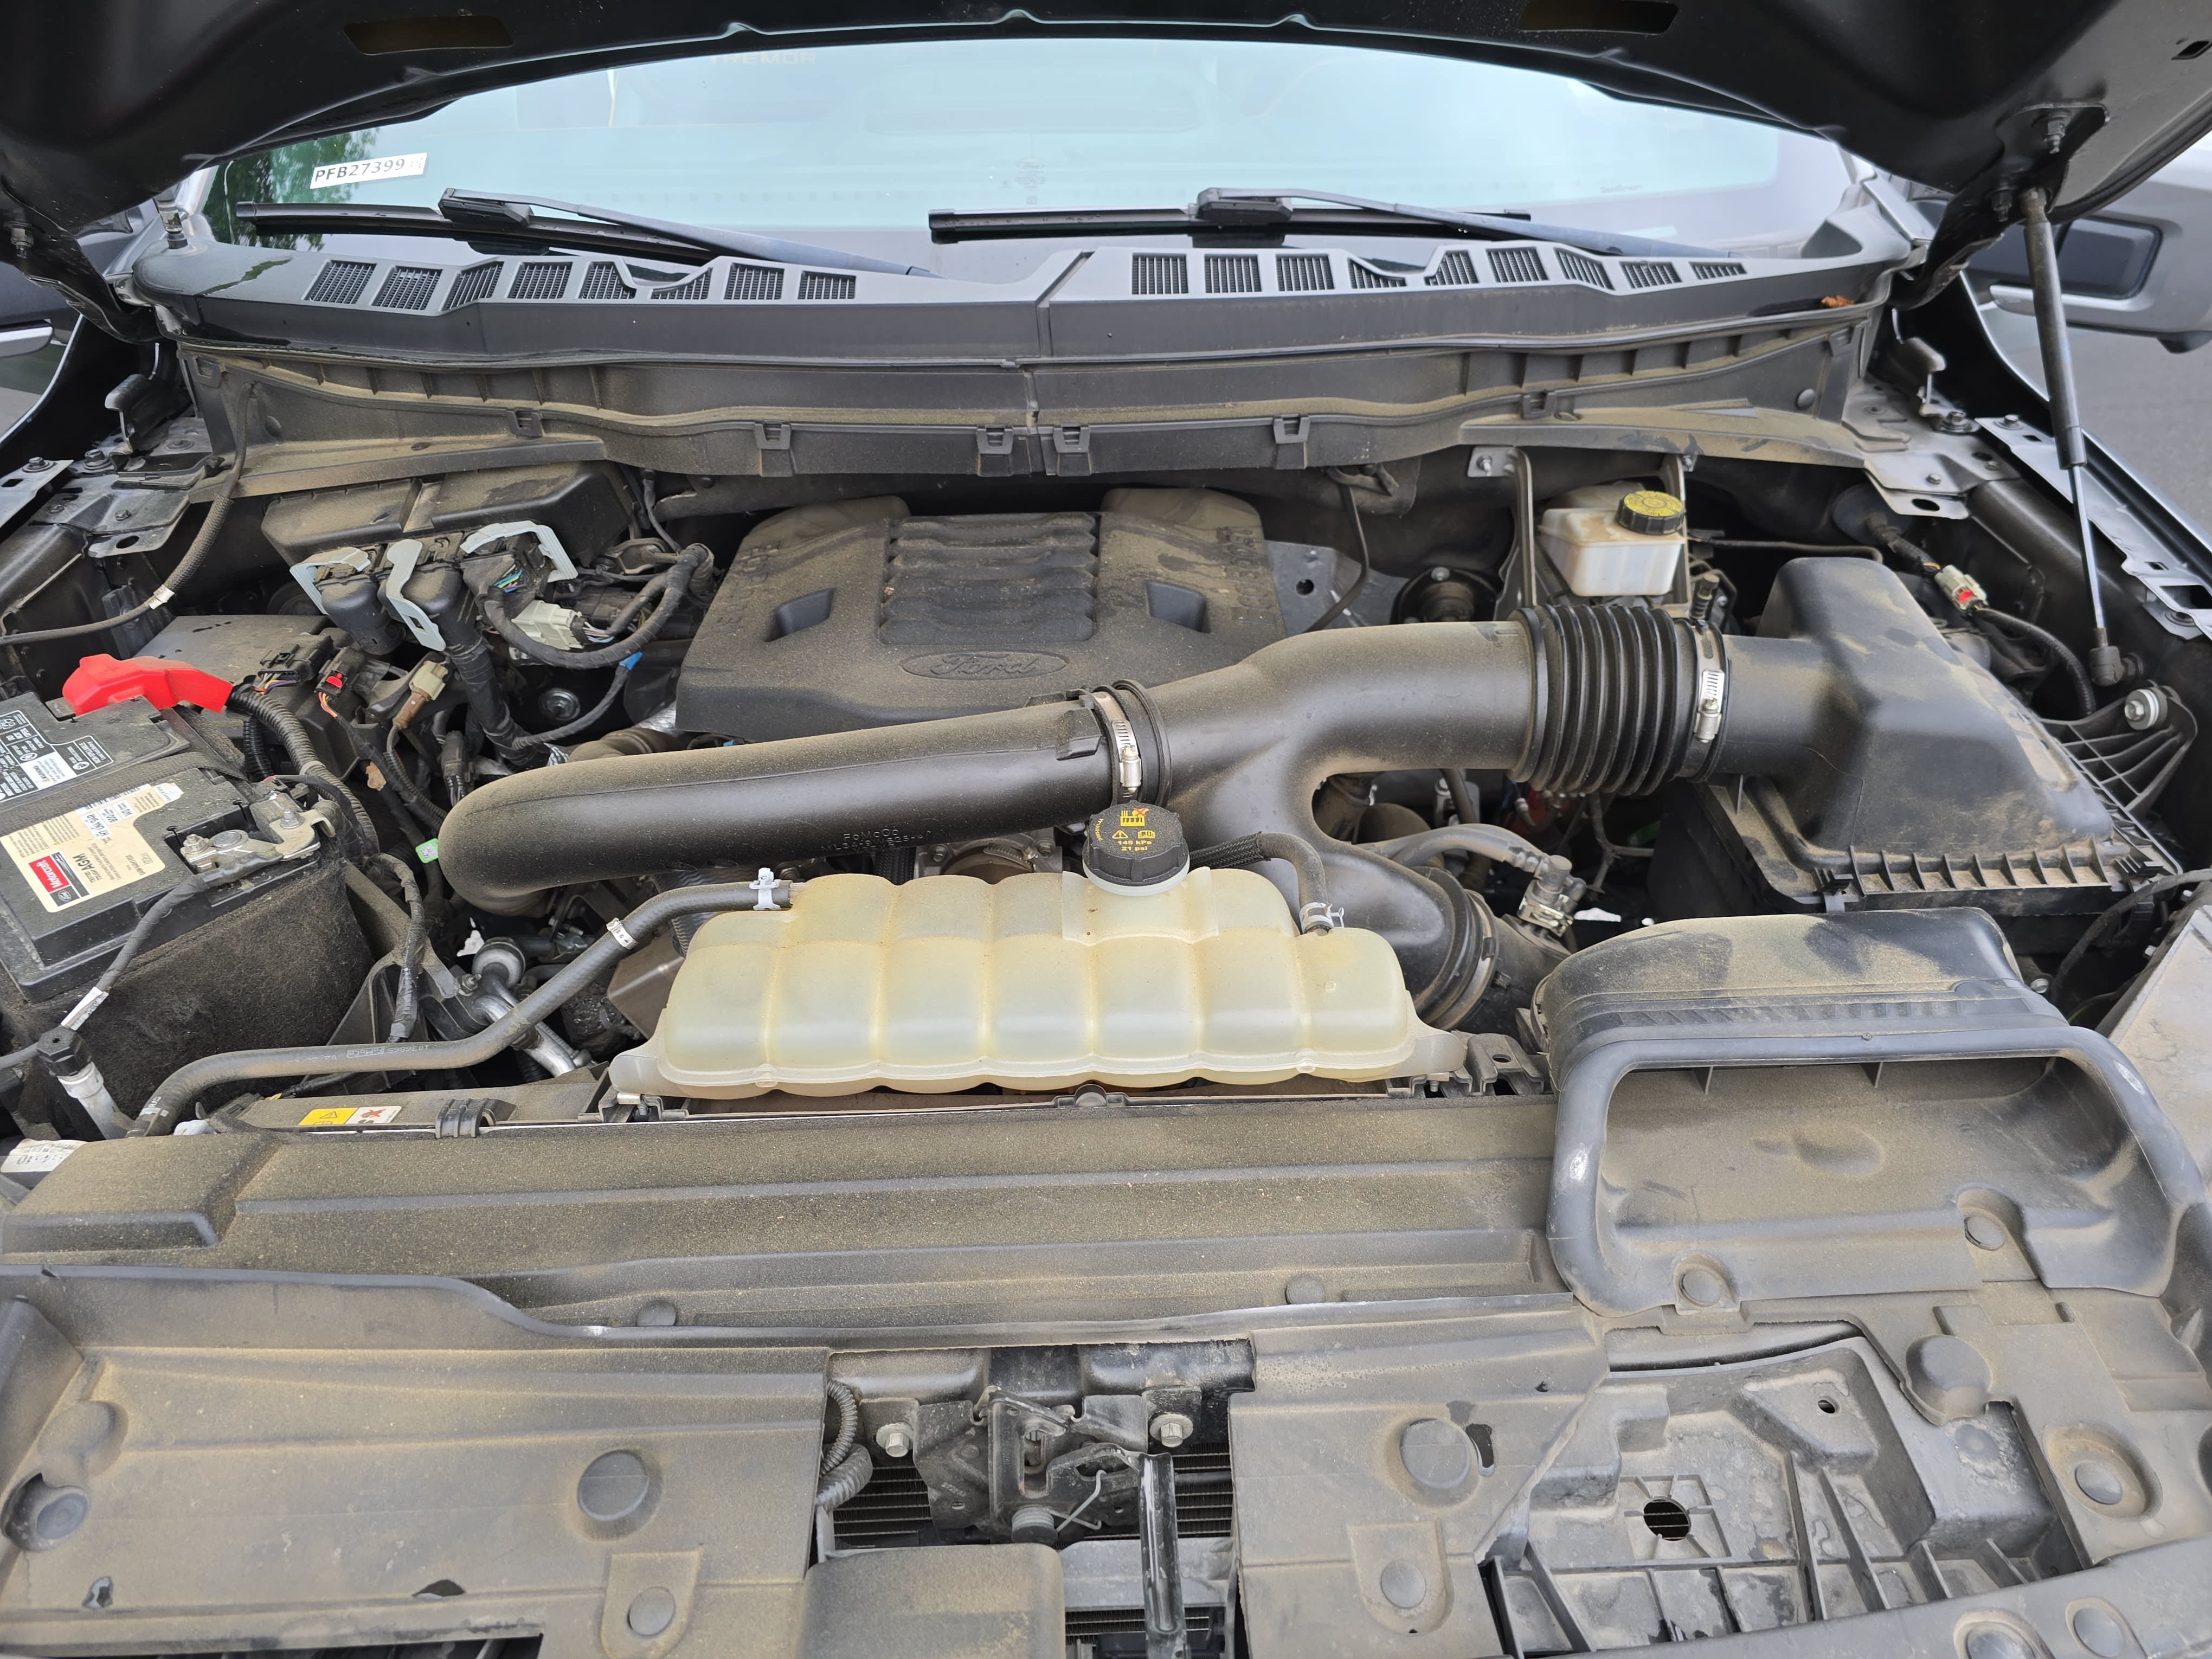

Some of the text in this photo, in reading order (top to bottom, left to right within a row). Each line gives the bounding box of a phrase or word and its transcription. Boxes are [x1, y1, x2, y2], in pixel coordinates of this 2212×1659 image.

[314, 158, 405, 182] PFB27399
[929, 653, 1039, 675] Ford
[844, 828, 899, 841] FoMoCo
[72, 853, 95, 871] AGM
[36, 859, 63, 888] Motorcraft
[348, 1047, 384, 1056] FoMoCo
[148, 1096, 162, 1107] RAD
